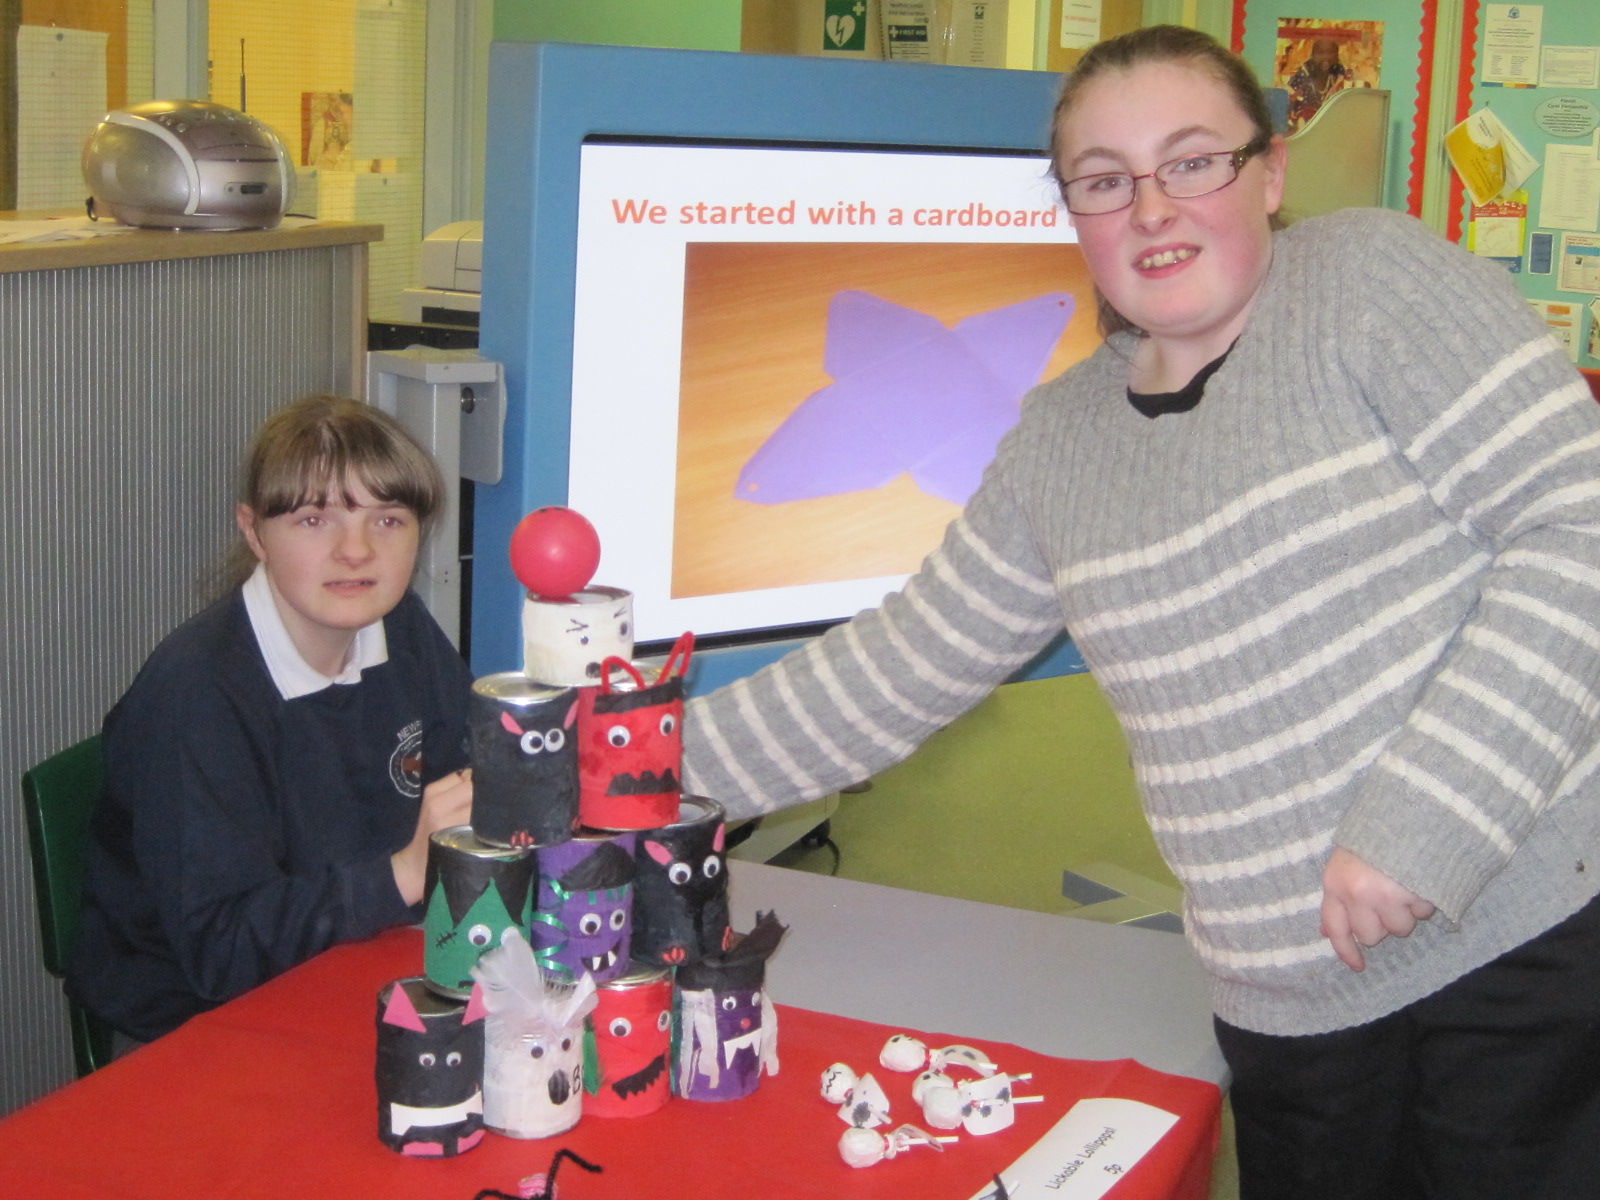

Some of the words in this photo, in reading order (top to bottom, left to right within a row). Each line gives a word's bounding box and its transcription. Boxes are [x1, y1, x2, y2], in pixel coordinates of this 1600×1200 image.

[612, 198, 667, 225] We
[679, 200, 796, 225] started
[807, 201, 876, 226] with
[887, 207, 904, 226] a
[913, 203, 1058, 228] cardboard
[1044, 1160, 1084, 1189] Lickable
[1103, 1163, 1124, 1175] 5p
